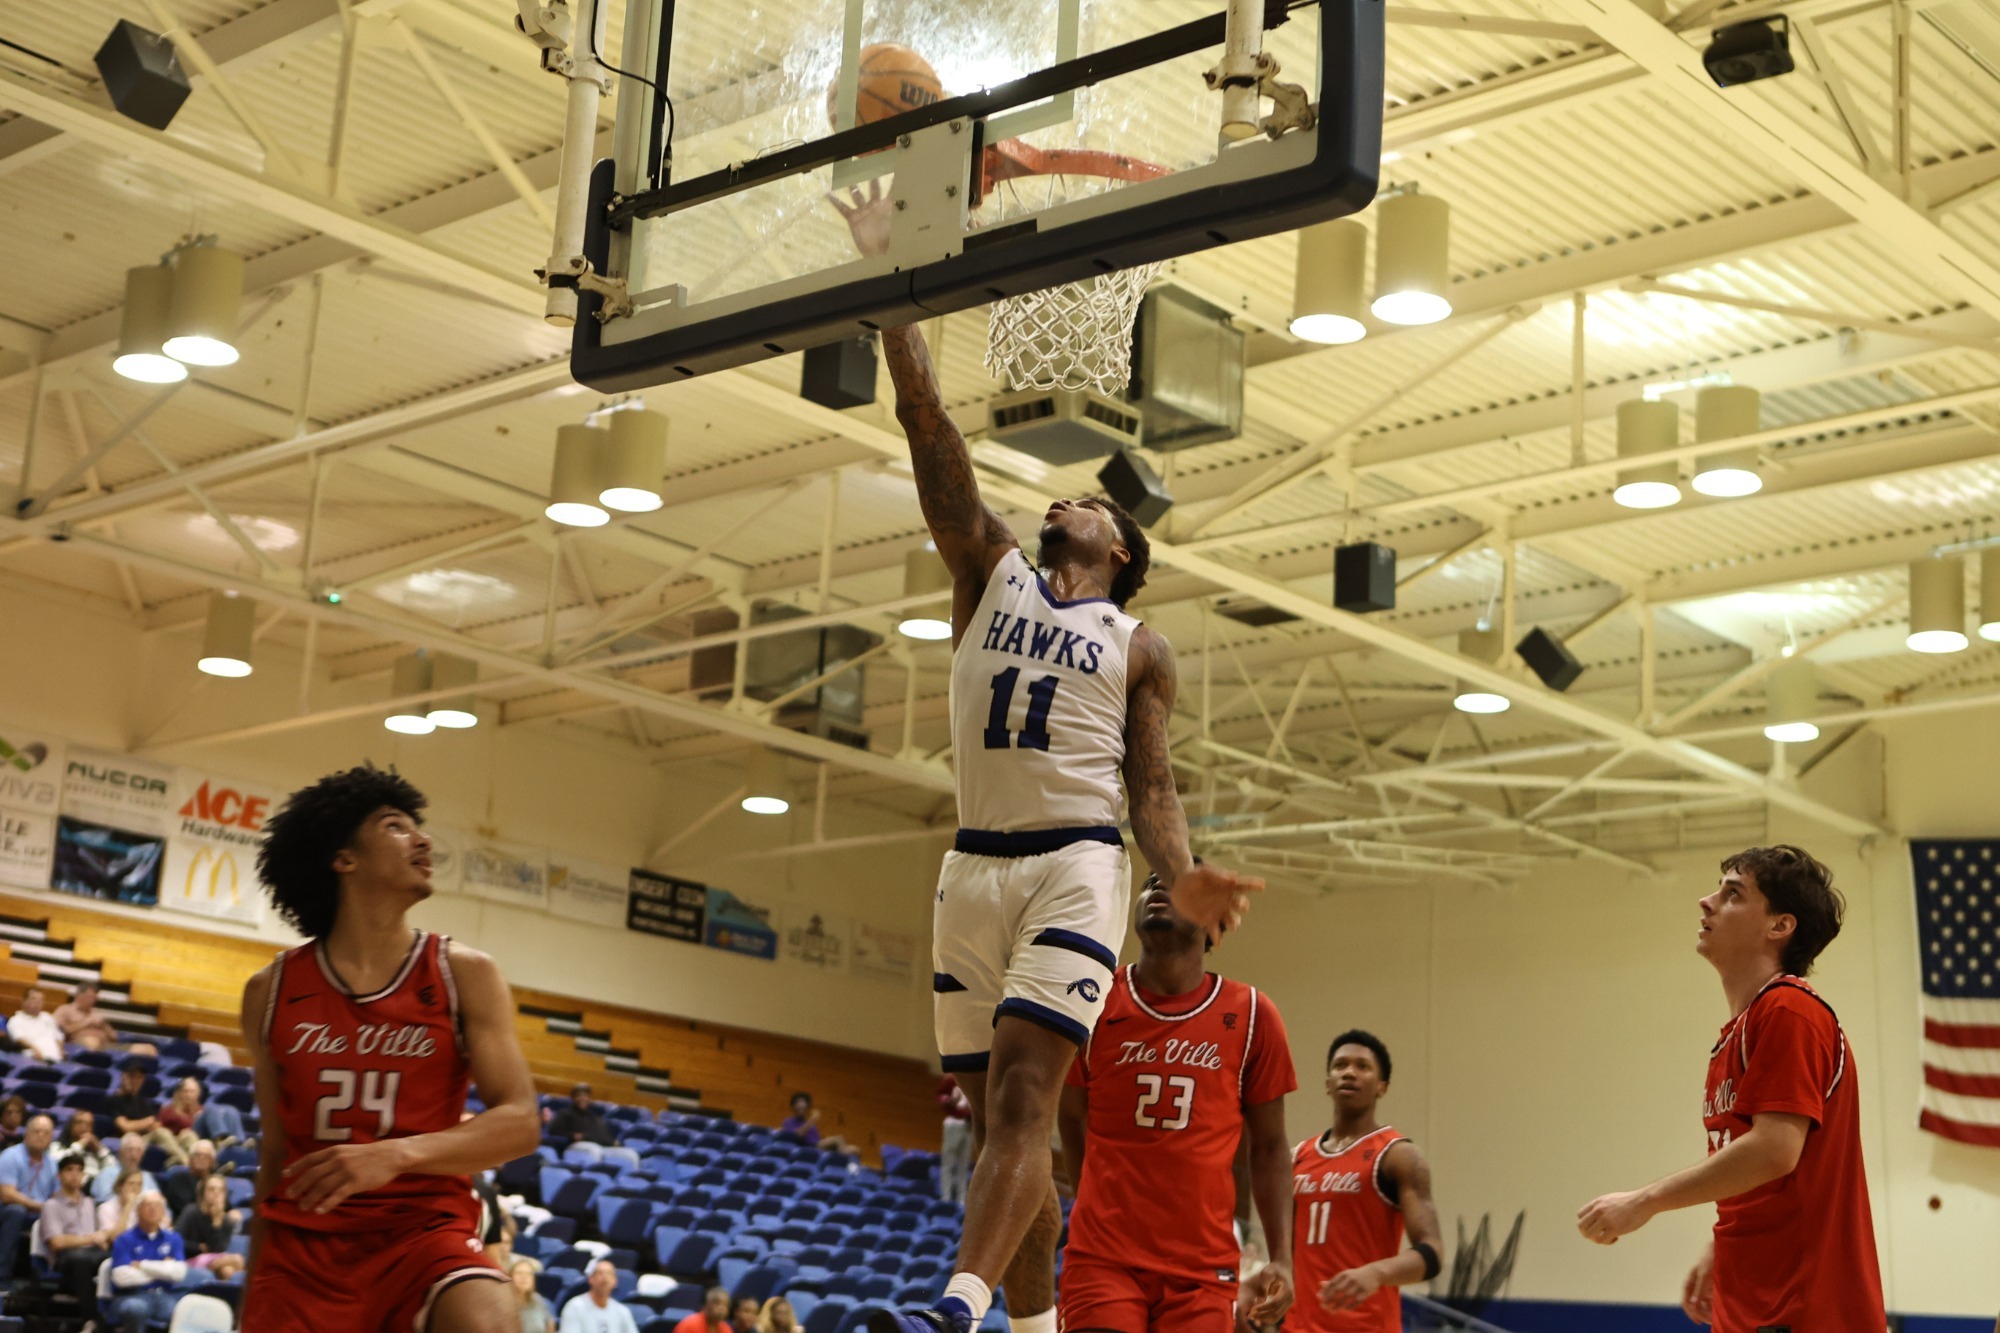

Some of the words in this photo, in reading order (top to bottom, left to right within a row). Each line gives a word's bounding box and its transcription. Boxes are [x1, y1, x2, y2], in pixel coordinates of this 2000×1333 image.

[982, 610, 1103, 675] HAWKS
[984, 666, 1060, 752] 11
[67, 761, 167, 794] NUCOR
[178, 779, 270, 832] ACE
[286, 1022, 349, 1055] The
[356, 1022, 437, 1058] Ville
[1115, 1041, 1157, 1066] The
[1163, 1038, 1222, 1070] Ville
[313, 1068, 401, 1141] 24
[1135, 1073, 1195, 1130] 23
[1293, 1173, 1317, 1196] The
[1320, 1171, 1361, 1193] Ville
[1306, 1201, 1331, 1245] 11
